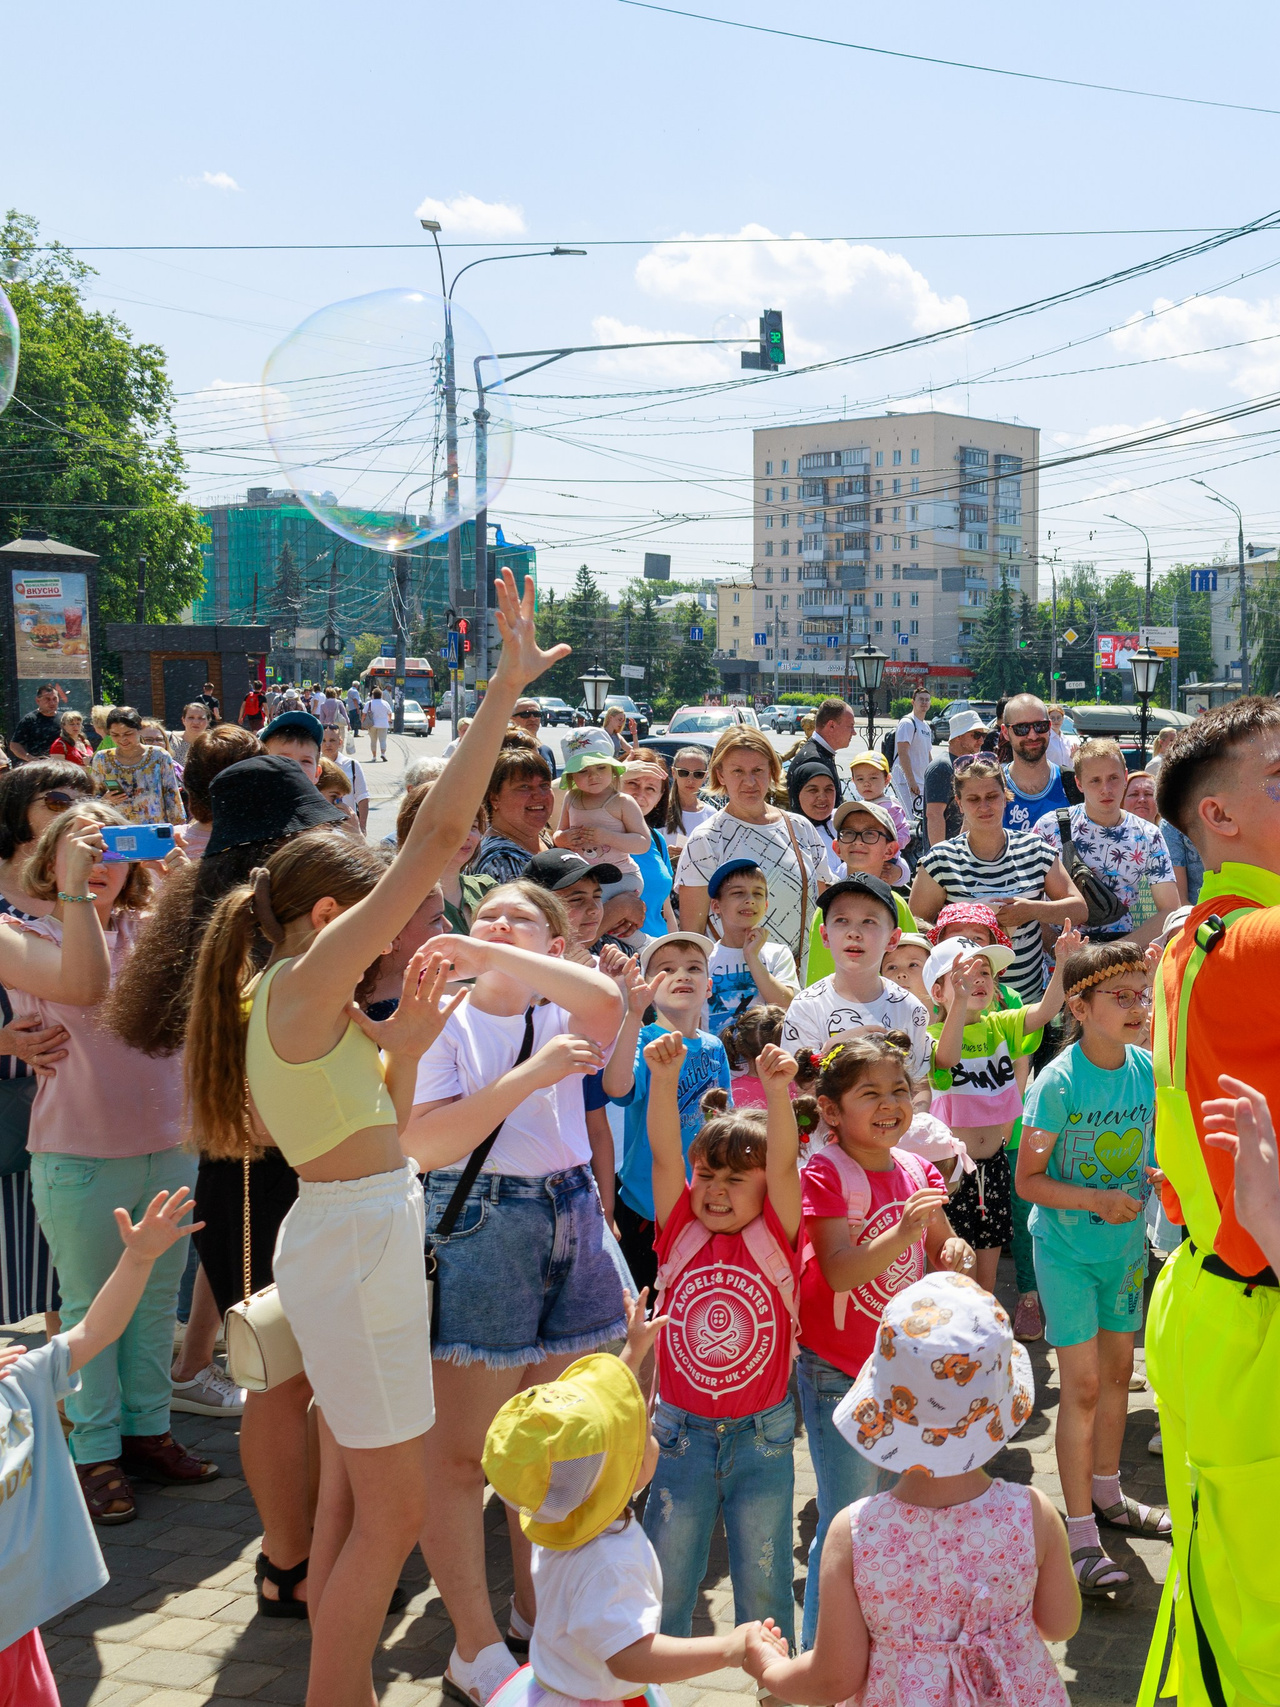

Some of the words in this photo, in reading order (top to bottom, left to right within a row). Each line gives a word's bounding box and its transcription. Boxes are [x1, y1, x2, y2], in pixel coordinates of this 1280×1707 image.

[26, 587, 60, 595] ВКУСНО
[1009, 804, 1029, 825] Los
[712, 963, 753, 984] SUR
[1087, 1103, 1154, 1127] never
[1100, 1134, 1139, 1160] and
[860, 1212, 894, 1244] NGELS
[675, 1274, 716, 1313] ANGELS
[715, 1272, 724, 1283] &
[726, 1273, 769, 1315] PIRATES
[672, 1332, 717, 1387] MANCHESTER
[725, 1370, 741, 1383] UK
[745, 1334, 770, 1372] MMXIV
[927, 1397, 946, 1411] Super
[880, 1447, 898, 1463] Super
[962, 1452, 976, 1473] Super
